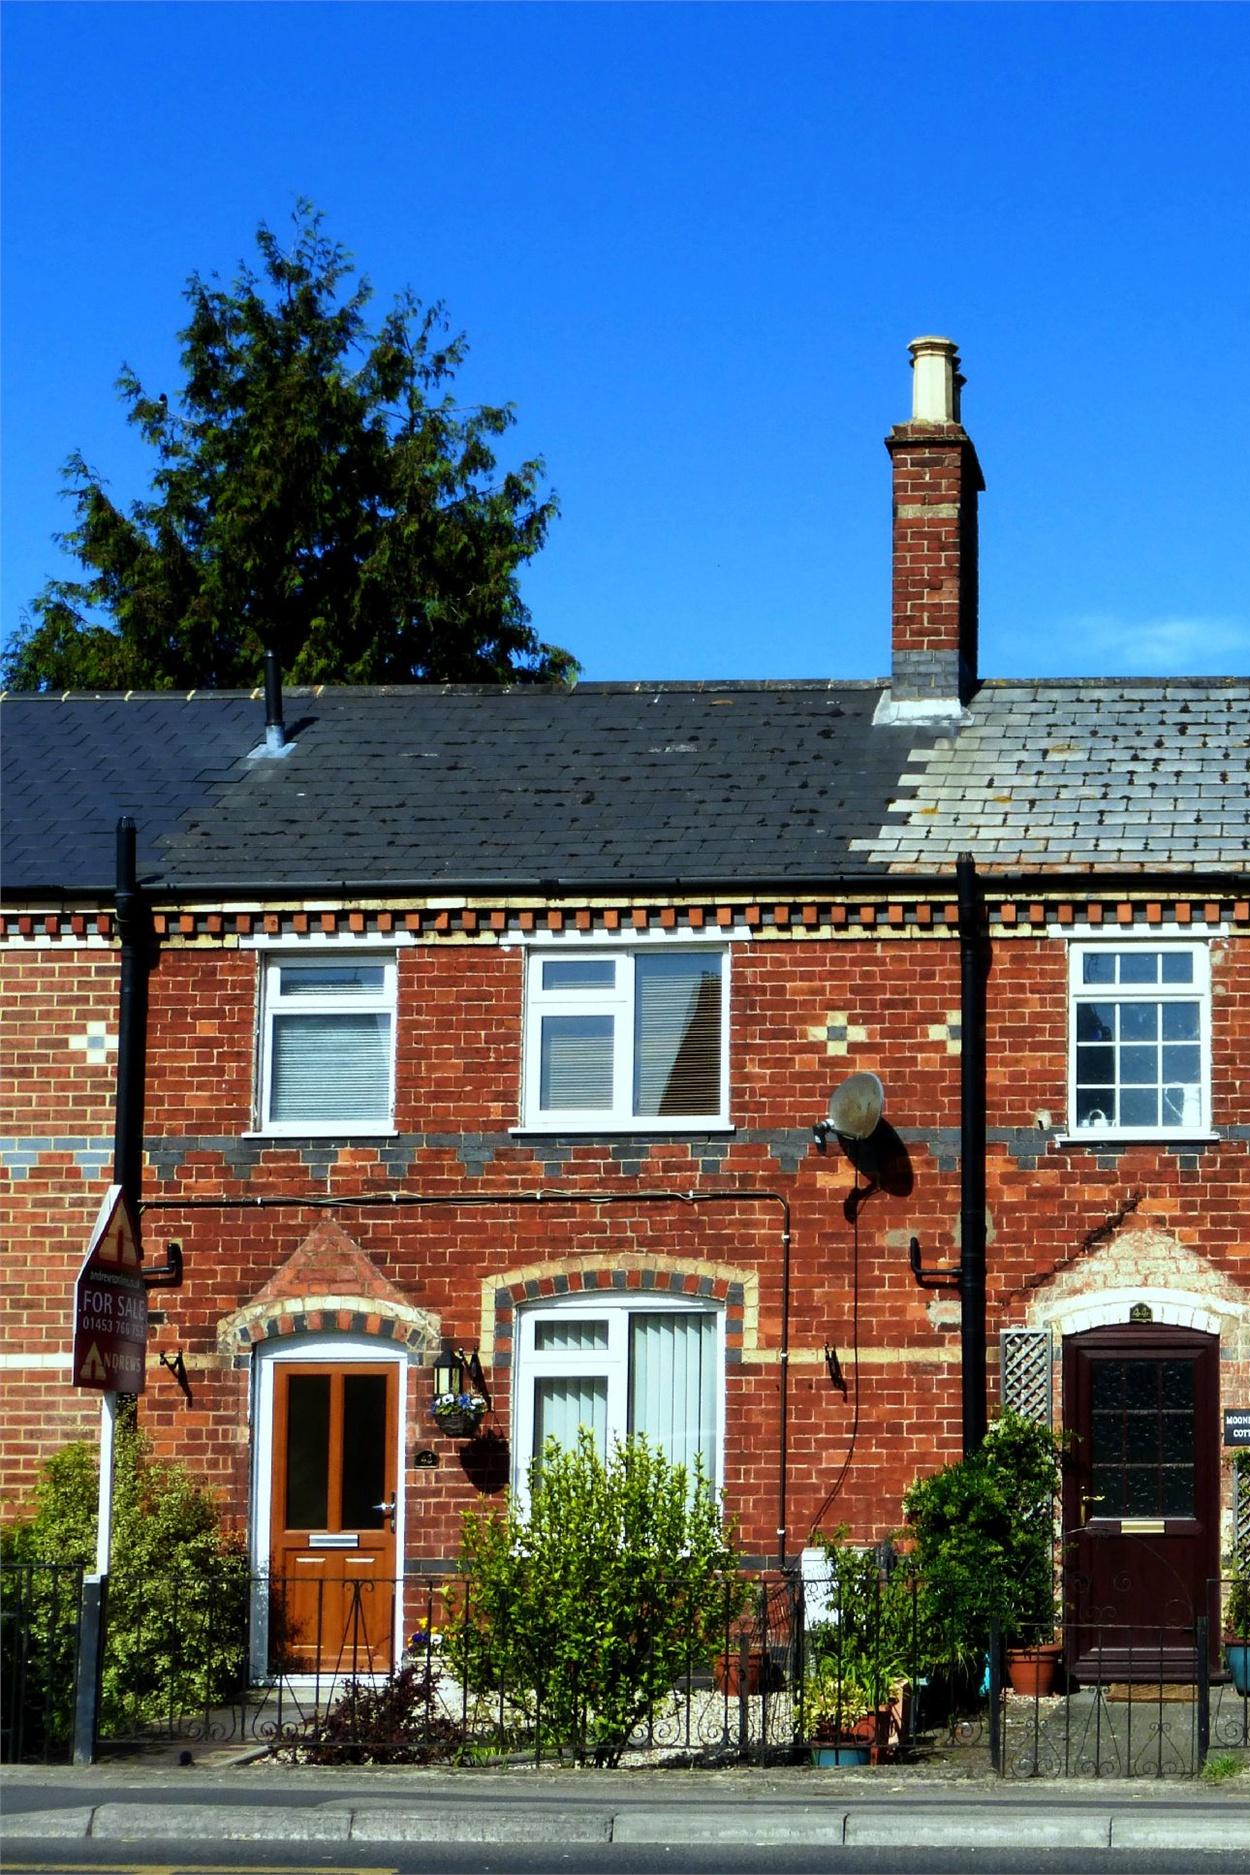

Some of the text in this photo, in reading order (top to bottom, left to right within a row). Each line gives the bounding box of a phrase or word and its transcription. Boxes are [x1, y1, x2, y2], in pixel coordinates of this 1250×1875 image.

[84, 1290, 145, 1320] FOR SALE
[83, 1316, 113, 1333] 01453
